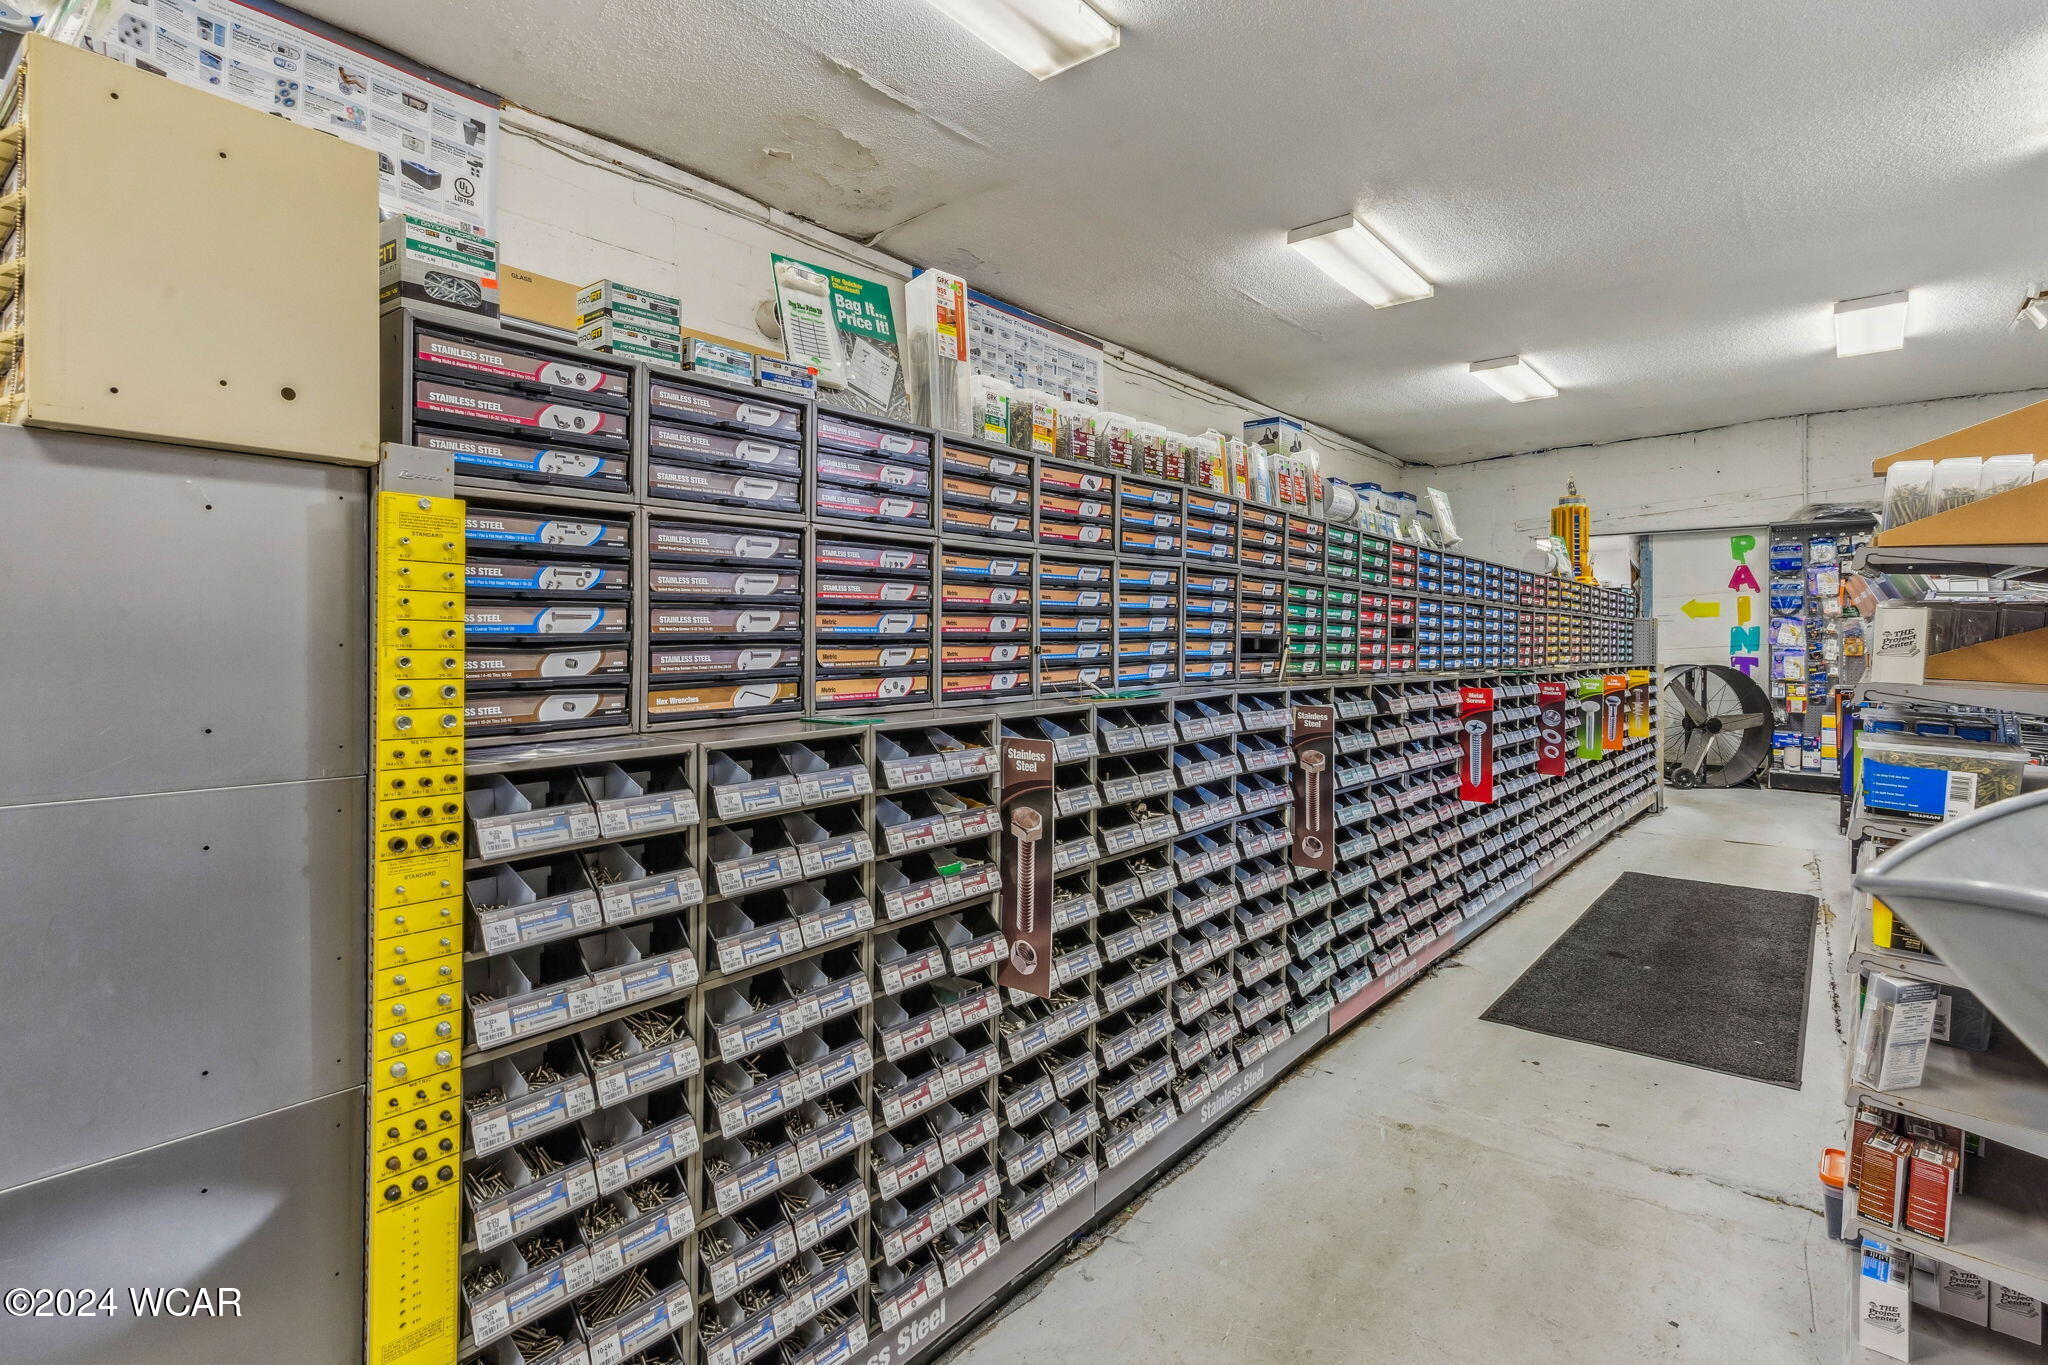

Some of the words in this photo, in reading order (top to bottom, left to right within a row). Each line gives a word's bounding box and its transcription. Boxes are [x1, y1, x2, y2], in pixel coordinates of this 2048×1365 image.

[454, 194, 475, 207] LISTED
[420, 220, 454, 235] DRYWALL
[511, 273, 532, 283] GLASS
[831, 276, 841, 284] For
[622, 286, 648, 297] DRYWALL
[577, 289, 602, 306] PROFIT
[834, 293, 862, 316] Bag
[864, 301, 887, 320] It...
[837, 309, 873, 330] Price
[876, 321, 890, 336] It!
[623, 324, 649, 334] DRYWALL
[578, 327, 602, 343] PROFIT
[431, 343, 477, 360] STAINLESS
[479, 354, 505, 366] STEEL
[429, 392, 476, 408] STAINLESS
[478, 400, 504, 412] STEEL
[659, 391, 692, 404] STAINLESS
[693, 398, 711, 408] STEEL
[986, 393, 997, 401] GRK
[1034, 404, 1045, 413] GRK
[658, 431, 691, 444] STAINLESS
[692, 437, 710, 447] STEEL
[429, 438, 476, 454] STAINLESS
[478, 446, 503, 456] STEEL
[656, 472, 690, 484] STAINLESS
[690, 476, 709, 486] STEEL
[480, 521, 505, 530] STEEL
[658, 534, 691, 544] STAINLESS
[691, 537, 710, 546] STEEL
[822, 549, 846, 558] STAINLESS
[478, 568, 503, 577] STEEL
[658, 576, 690, 584] STAINLESS
[691, 577, 709, 585] STEEL
[822, 584, 848, 592] STAINLESS
[848, 584, 862, 592] STEEL
[1728, 534, 1761, 677] PAINT
[477, 614, 502, 623] STEEL
[659, 616, 692, 624] STAINLESS
[692, 616, 711, 624] STEEL
[821, 618, 837, 626] Metric
[1893, 627, 1915, 636] THE
[1882, 633, 1917, 645] Project
[1881, 640, 1915, 650] Center
[480, 660, 505, 669] STEEL
[660, 656, 694, 664] STAINLESS
[656, 698, 668, 706] Hex
[669, 696, 700, 705] Wrenches
[478, 706, 503, 716] STEEL
[1297, 711, 1328, 721] Stainless
[1304, 719, 1322, 728] Steel
[1008, 748, 1046, 762] Stainless
[1016, 761, 1037, 773] Steel
[1908, 812, 1941, 820] HILLMAN
[404, 871, 437, 880] STANDARD
[513, 1003, 538, 1016] Stainless
[539, 1000, 552, 1008] Steel
[409, 1078, 432, 1088] METRIC
[1200, 1083, 1242, 1124] Stainless
[1243, 1062, 1264, 1091] Steel
[511, 1105, 535, 1120] Stainless
[536, 1100, 550, 1110] Steel
[512, 1197, 537, 1212] Stainless
[538, 1190, 552, 1201] Steel
[1864, 1213, 1889, 1225] HILLMAN
[622, 1230, 643, 1245] Stainless
[644, 1224, 656, 1235] Steel
[1914, 1228, 1940, 1240] HILLMAN
[1949, 1276, 1981, 1285] Project
[1960, 1272, 1979, 1280] THE
[509, 1286, 533, 1303] Stainless
[534, 1278, 548, 1290] Steel
[1948, 1281, 1980, 1290] Center
[2000, 1292, 2034, 1302] Project
[2000, 1298, 2032, 1307] Center
[1868, 1308, 1901, 1318] Project
[1878, 1304, 1899, 1313] THE
[1868, 1314, 1898, 1323] Center
[621, 1319, 642, 1337] Stainless
[643, 1313, 655, 1323] Steel
[897, 1297, 946, 1356] Steel
[597, 1342, 613, 1355] 10-24x
